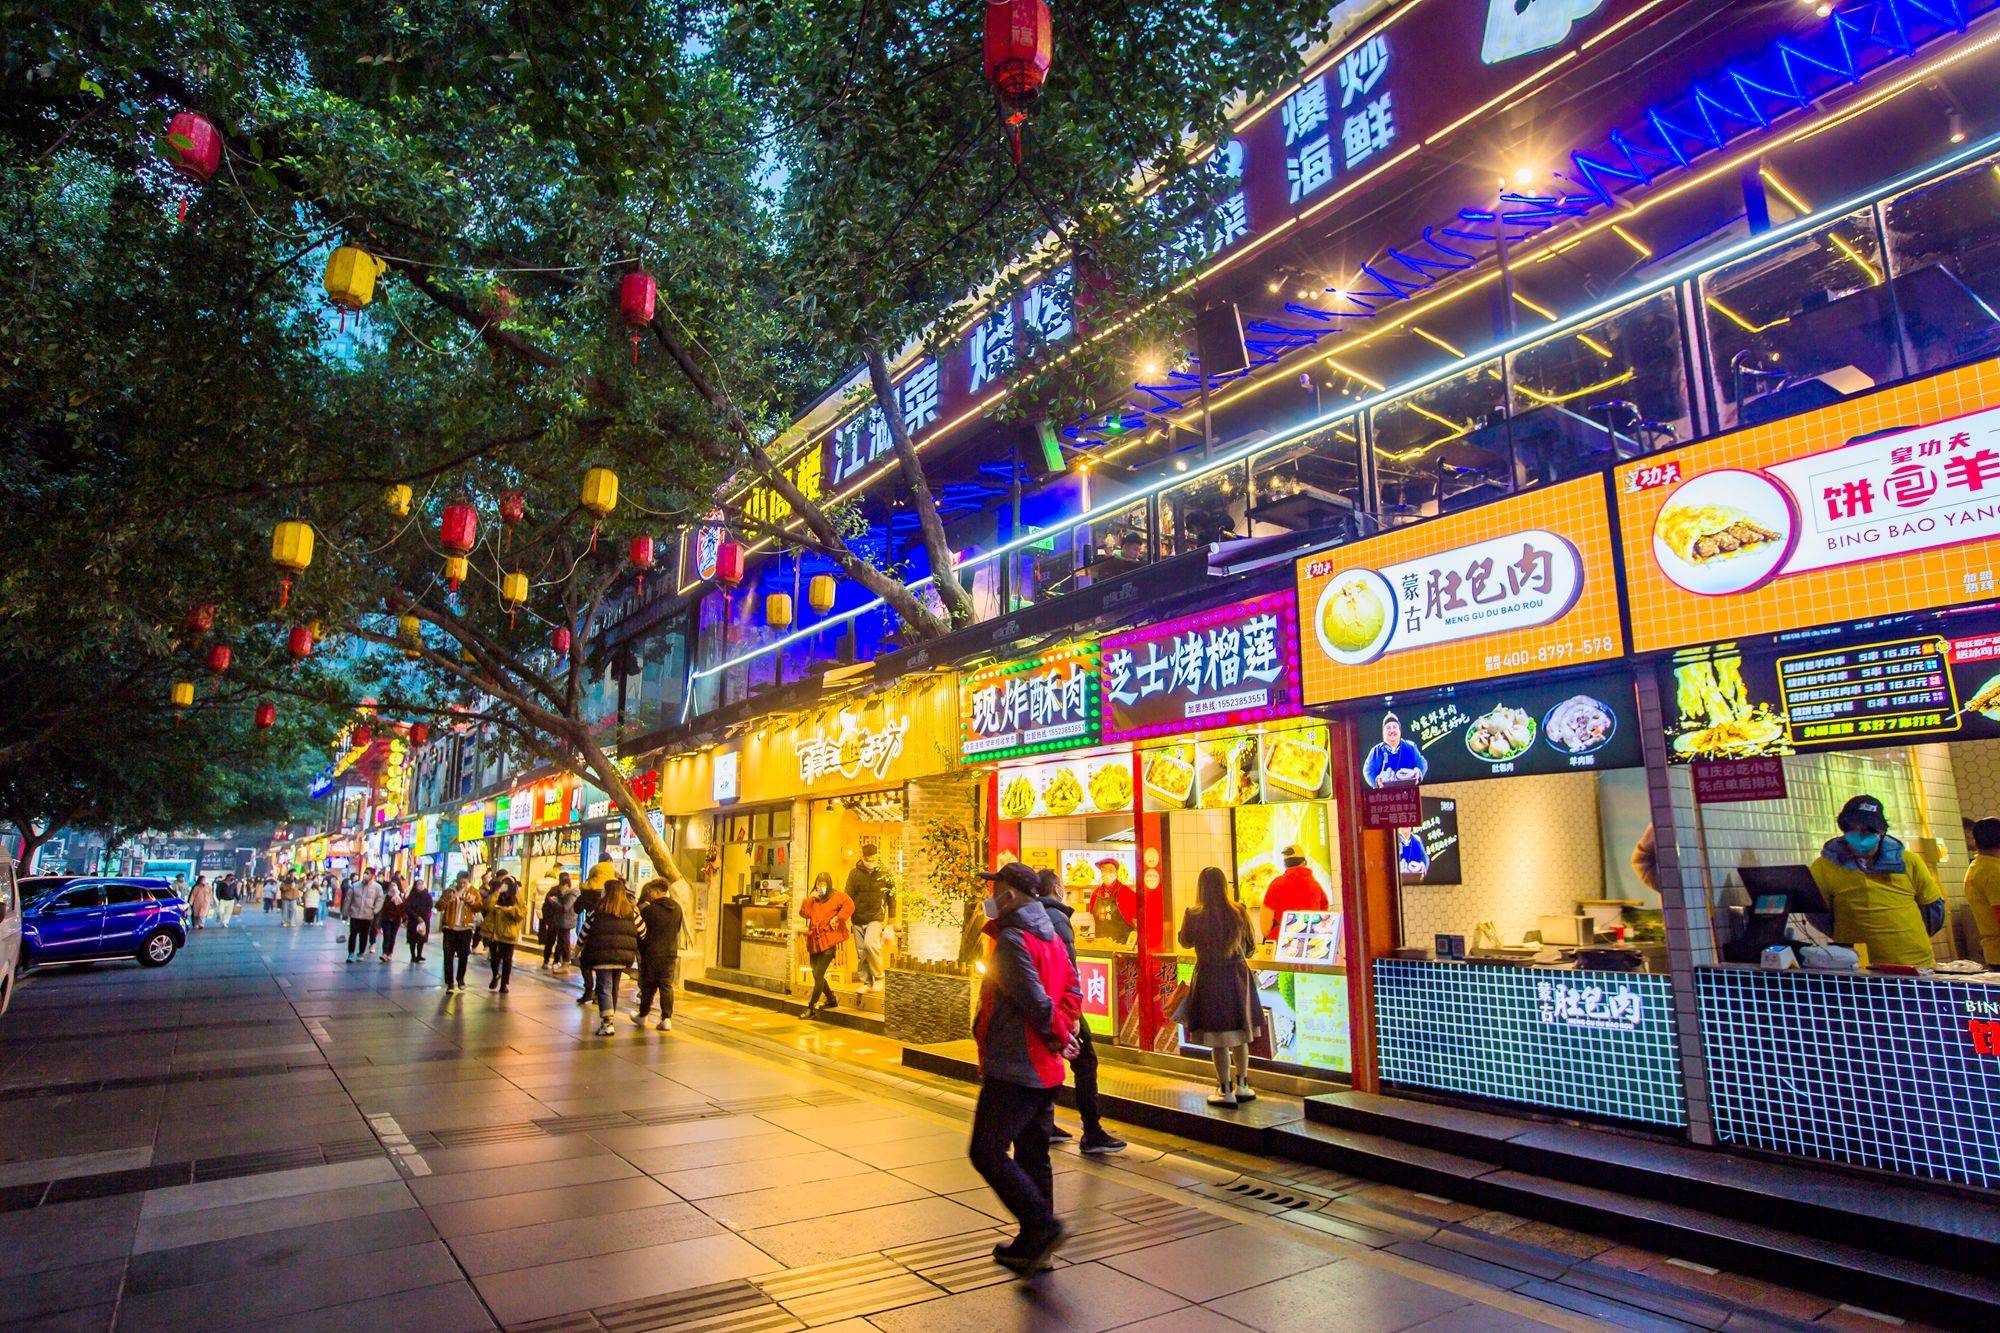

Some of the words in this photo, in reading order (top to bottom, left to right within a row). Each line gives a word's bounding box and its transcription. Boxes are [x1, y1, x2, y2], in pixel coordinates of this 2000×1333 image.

[1282, 35, 1388, 147] 爆炒
[1287, 92, 1395, 204] 海鲜
[1891, 432, 1970, 465] 皇功夫
[1827, 529, 1880, 550] BING
[1889, 517, 1935, 538] BAO
[1944, 503, 2000, 527] YAN
[1402, 573, 1421, 634] 蒙古
[1425, 543, 1552, 620] 肚包肉
[1445, 613, 1470, 626] MENG
[1472, 611, 1485, 621] GU
[1487, 608, 1499, 618] DU
[1501, 604, 1521, 615] BAO
[1522, 599, 1544, 610] ROU
[1106, 613, 1283, 706] 芝士烤榴莲
[1503, 636, 1613, 667] 400-8797-578
[972, 664, 1086, 736] 现炸酥肉
[1554, 984, 1640, 1025] 肚包肉
[1965, 1000, 2000, 1015] BIN
